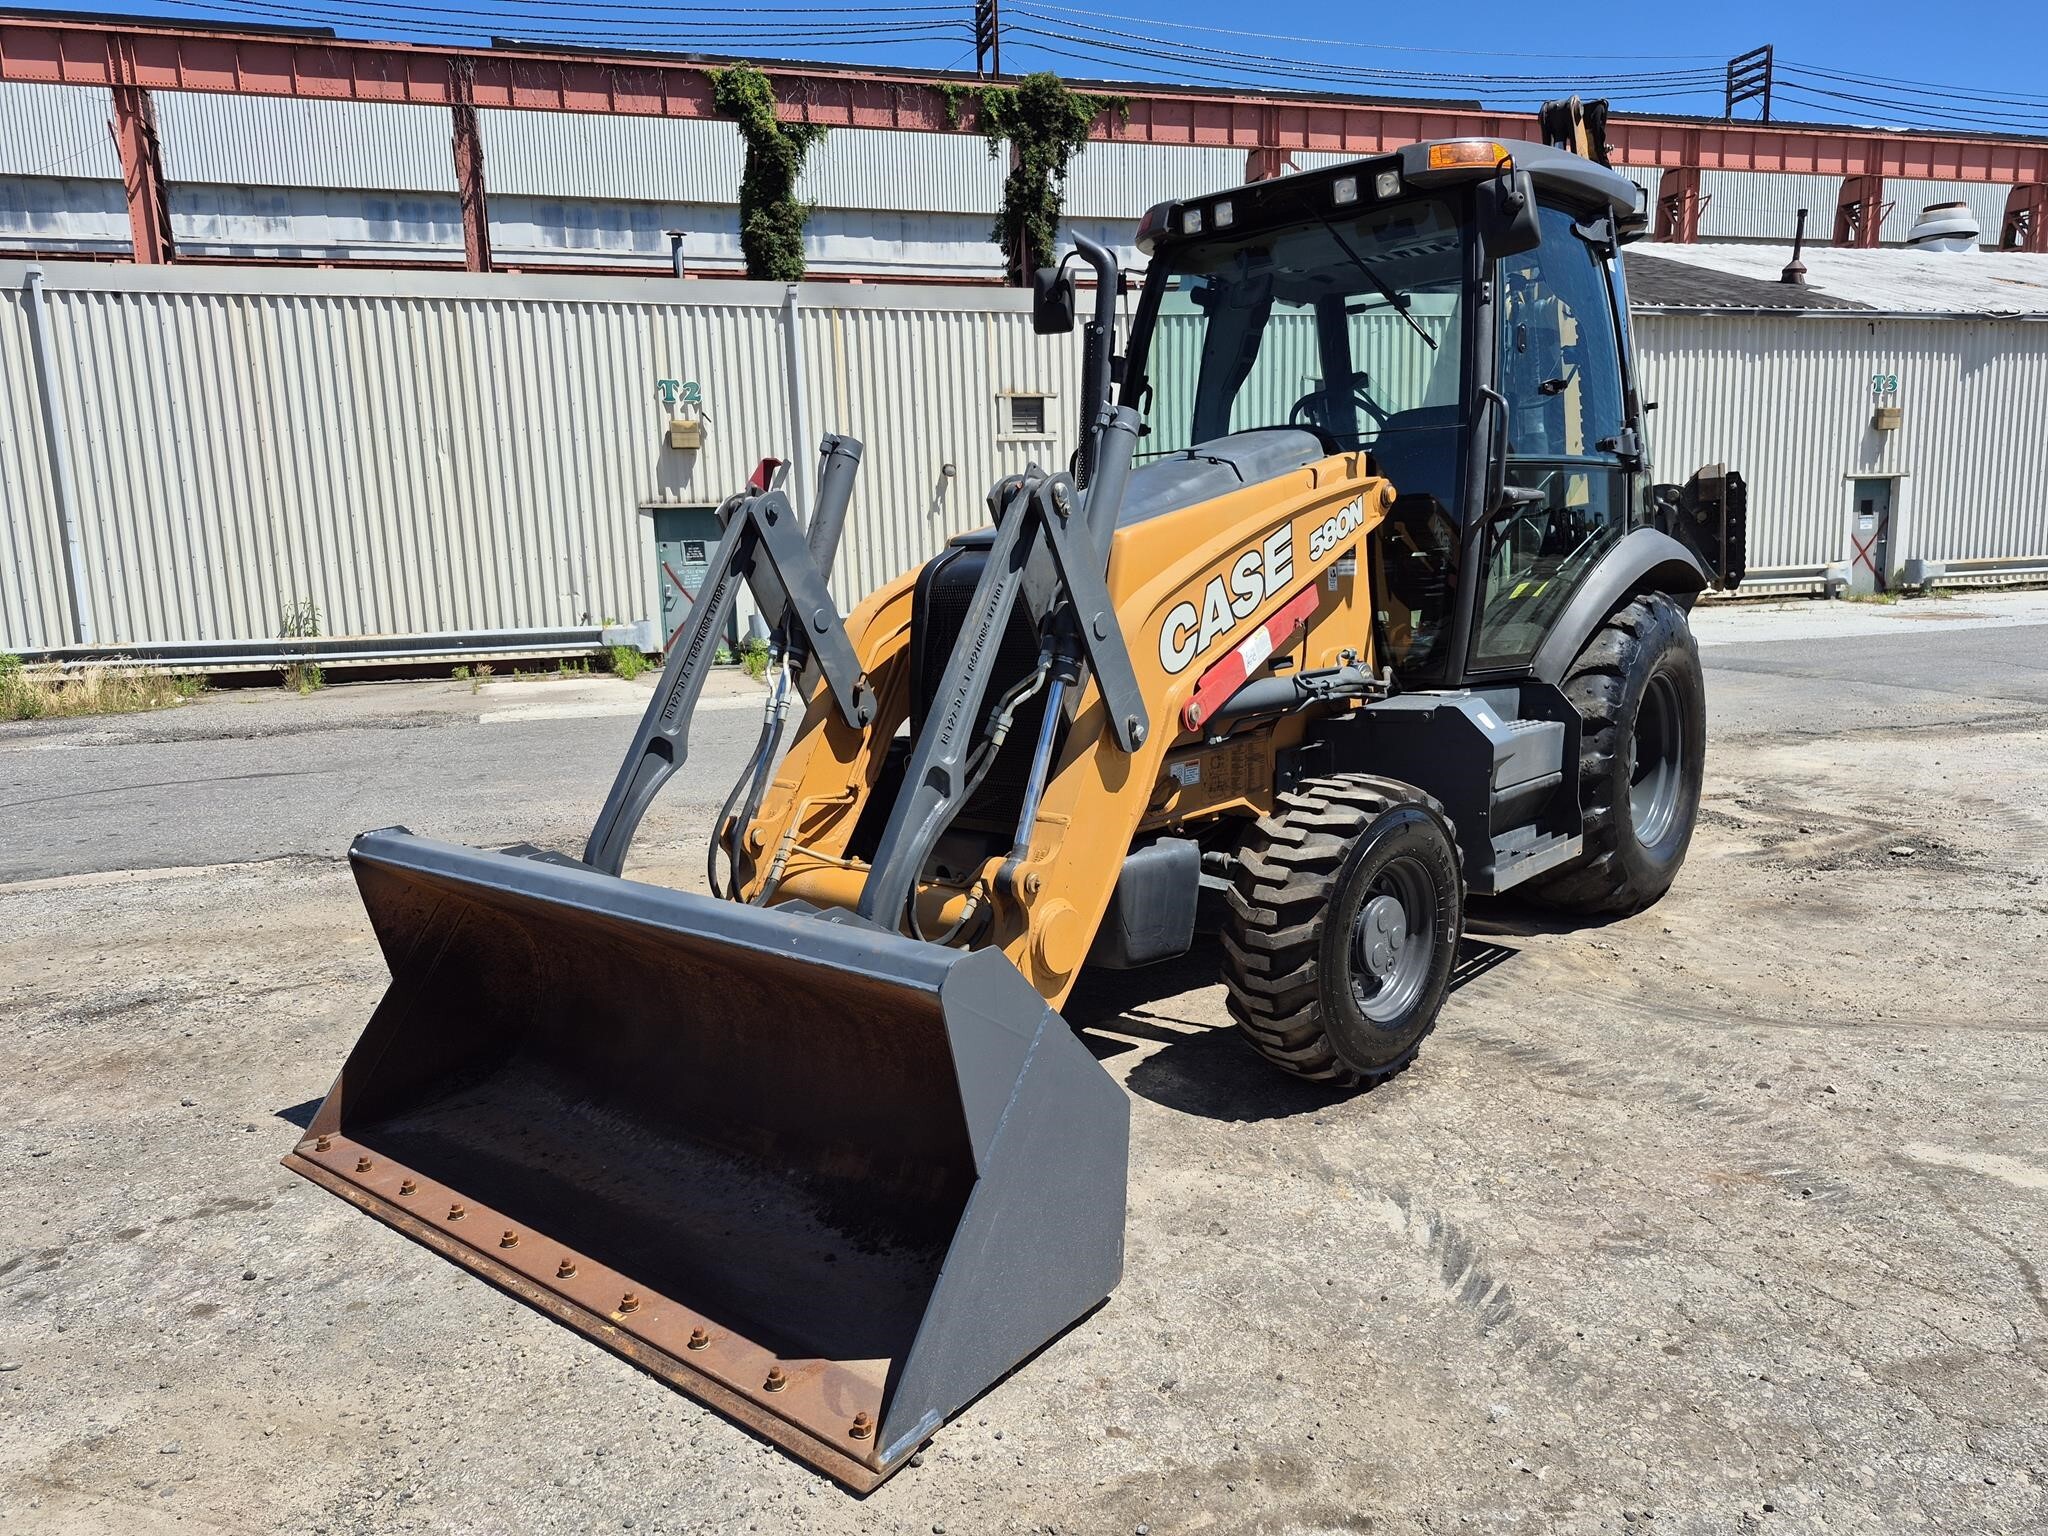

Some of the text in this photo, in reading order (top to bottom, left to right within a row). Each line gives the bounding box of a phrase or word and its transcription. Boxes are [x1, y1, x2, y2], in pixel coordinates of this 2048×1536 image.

[656, 379, 702, 404] T2
[1872, 374, 1898, 393] T3
[1308, 496, 1365, 562] 580N
[1158, 520, 1294, 675] CASE
